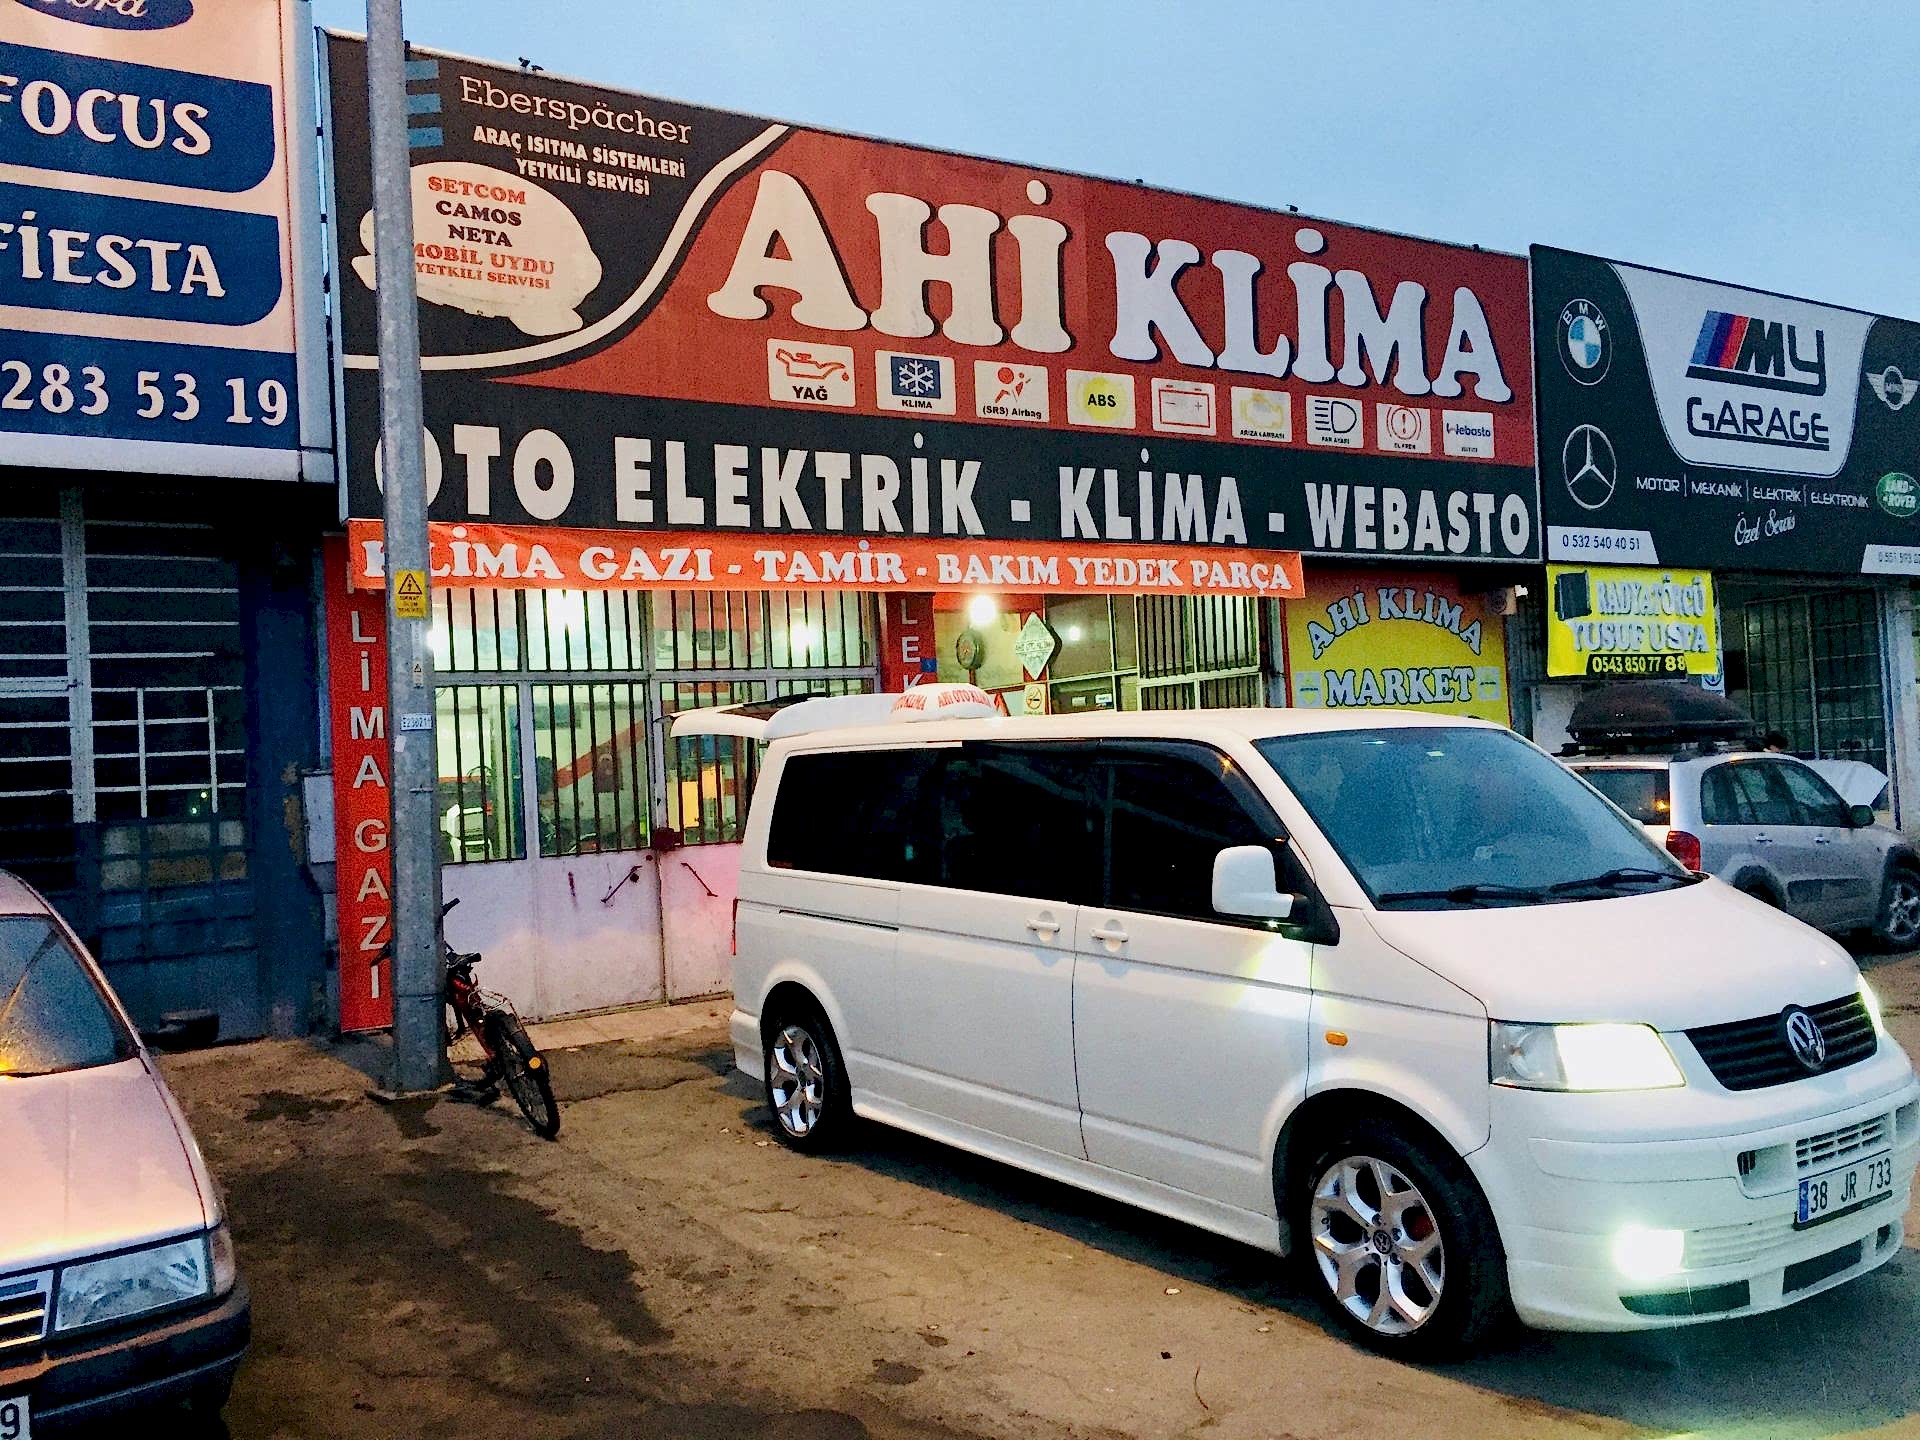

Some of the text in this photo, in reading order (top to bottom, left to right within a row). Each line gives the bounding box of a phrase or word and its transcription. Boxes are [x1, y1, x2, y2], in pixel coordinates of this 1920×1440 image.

[460, 76, 691, 144] Eberspächer
[473, 126, 685, 178] ARAÇ ISITMA SİSTEMLERİ
[428, 176, 526, 205] SETCOM
[515, 158, 649, 196] YETKİLİ SERVİSİ
[436, 200, 522, 226] CAMOS
[448, 224, 512, 247] NETA
[491, 253, 555, 275] UYDU
[707, 170, 1511, 402] AHİ KLİMA
[1562, 302, 1606, 332] BMW
[1, 361, 288, 427] 283 53 19
[792, 383, 828, 401] YAĞ
[1087, 394, 1116, 408] ABS
[982, 405, 1042, 420] (SRS) Airbag
[1687, 397, 1829, 451] GARAGE
[614, 432, 986, 536] ELEKTRİK
[1059, 448, 1247, 544] KLİMA
[1304, 482, 1530, 556] WEBASTO
[1637, 477, 1679, 492] MOTOR
[1562, 534, 1640, 550] 0 532 540 40 51
[579, 546, 714, 582] GAZI
[753, 540, 907, 584] TAMİR
[936, 553, 1060, 586] BAKIM
[1067, 556, 1184, 587] YEDEK
[1190, 559, 1292, 594] PARÇA
[1307, 585, 1482, 660] AHİ KLİMA
[1570, 621, 1709, 652] YUSUF USTA
[346, 560, 385, 788] LİMA
[1592, 655, 1686, 673] 0543 850 77 88
[1324, 666, 1475, 707] MARKET
[354, 819, 389, 999] GAZI
[1811, 1158, 1892, 1213] 38 JR 733
[0, 1403, 20, 1440] 9
